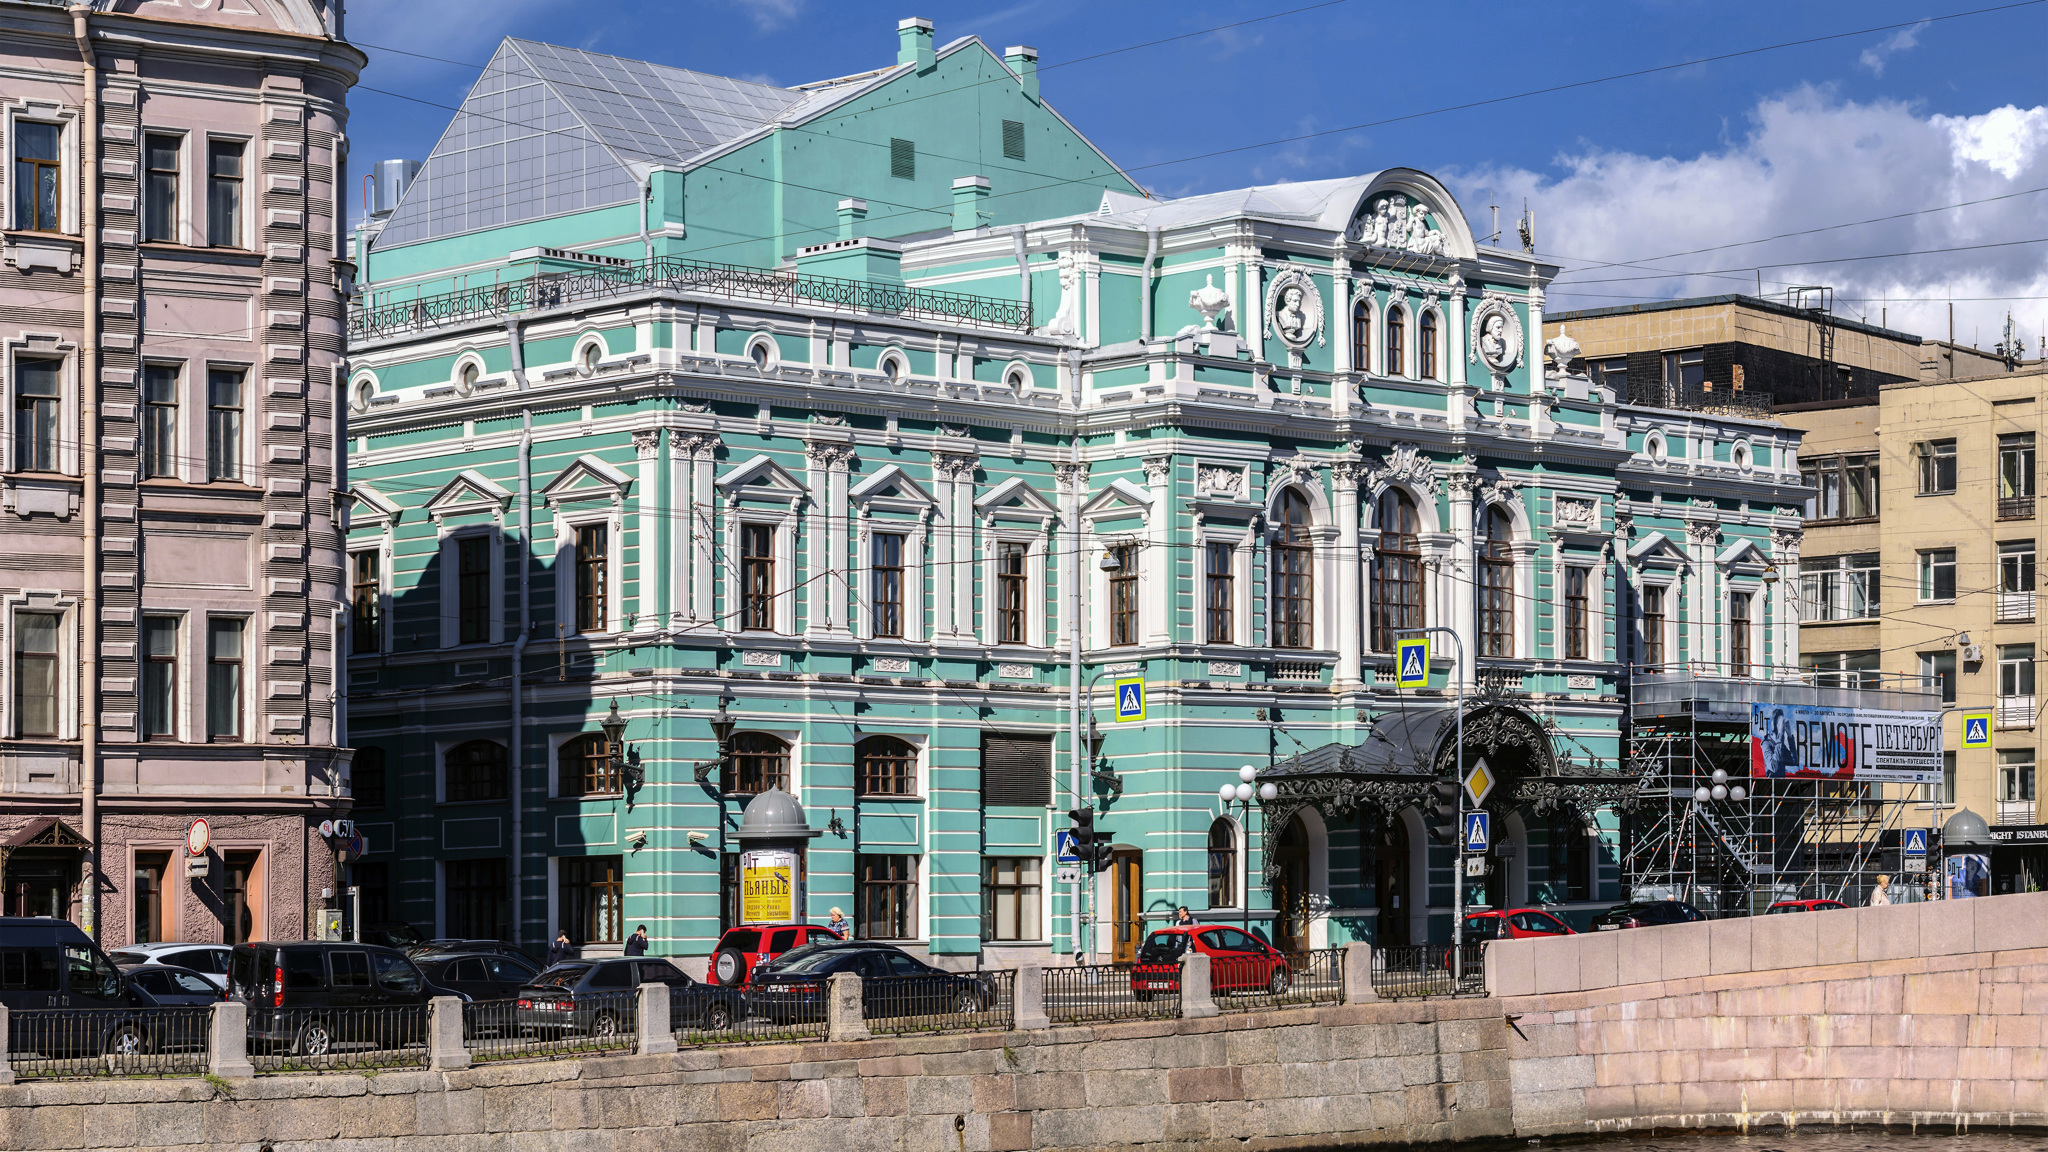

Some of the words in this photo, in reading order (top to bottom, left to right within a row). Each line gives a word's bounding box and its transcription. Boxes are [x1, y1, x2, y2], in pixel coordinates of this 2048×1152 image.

[1754, 705, 1770, 736] БДТ
[1796, 720, 1872, 769] REMOTE
[1875, 724, 1942, 751] ПЕТЕРБУРГ
[1948, 859, 1962, 879] БДТ
[744, 880, 788, 895] ПЬЯНЫЕ
